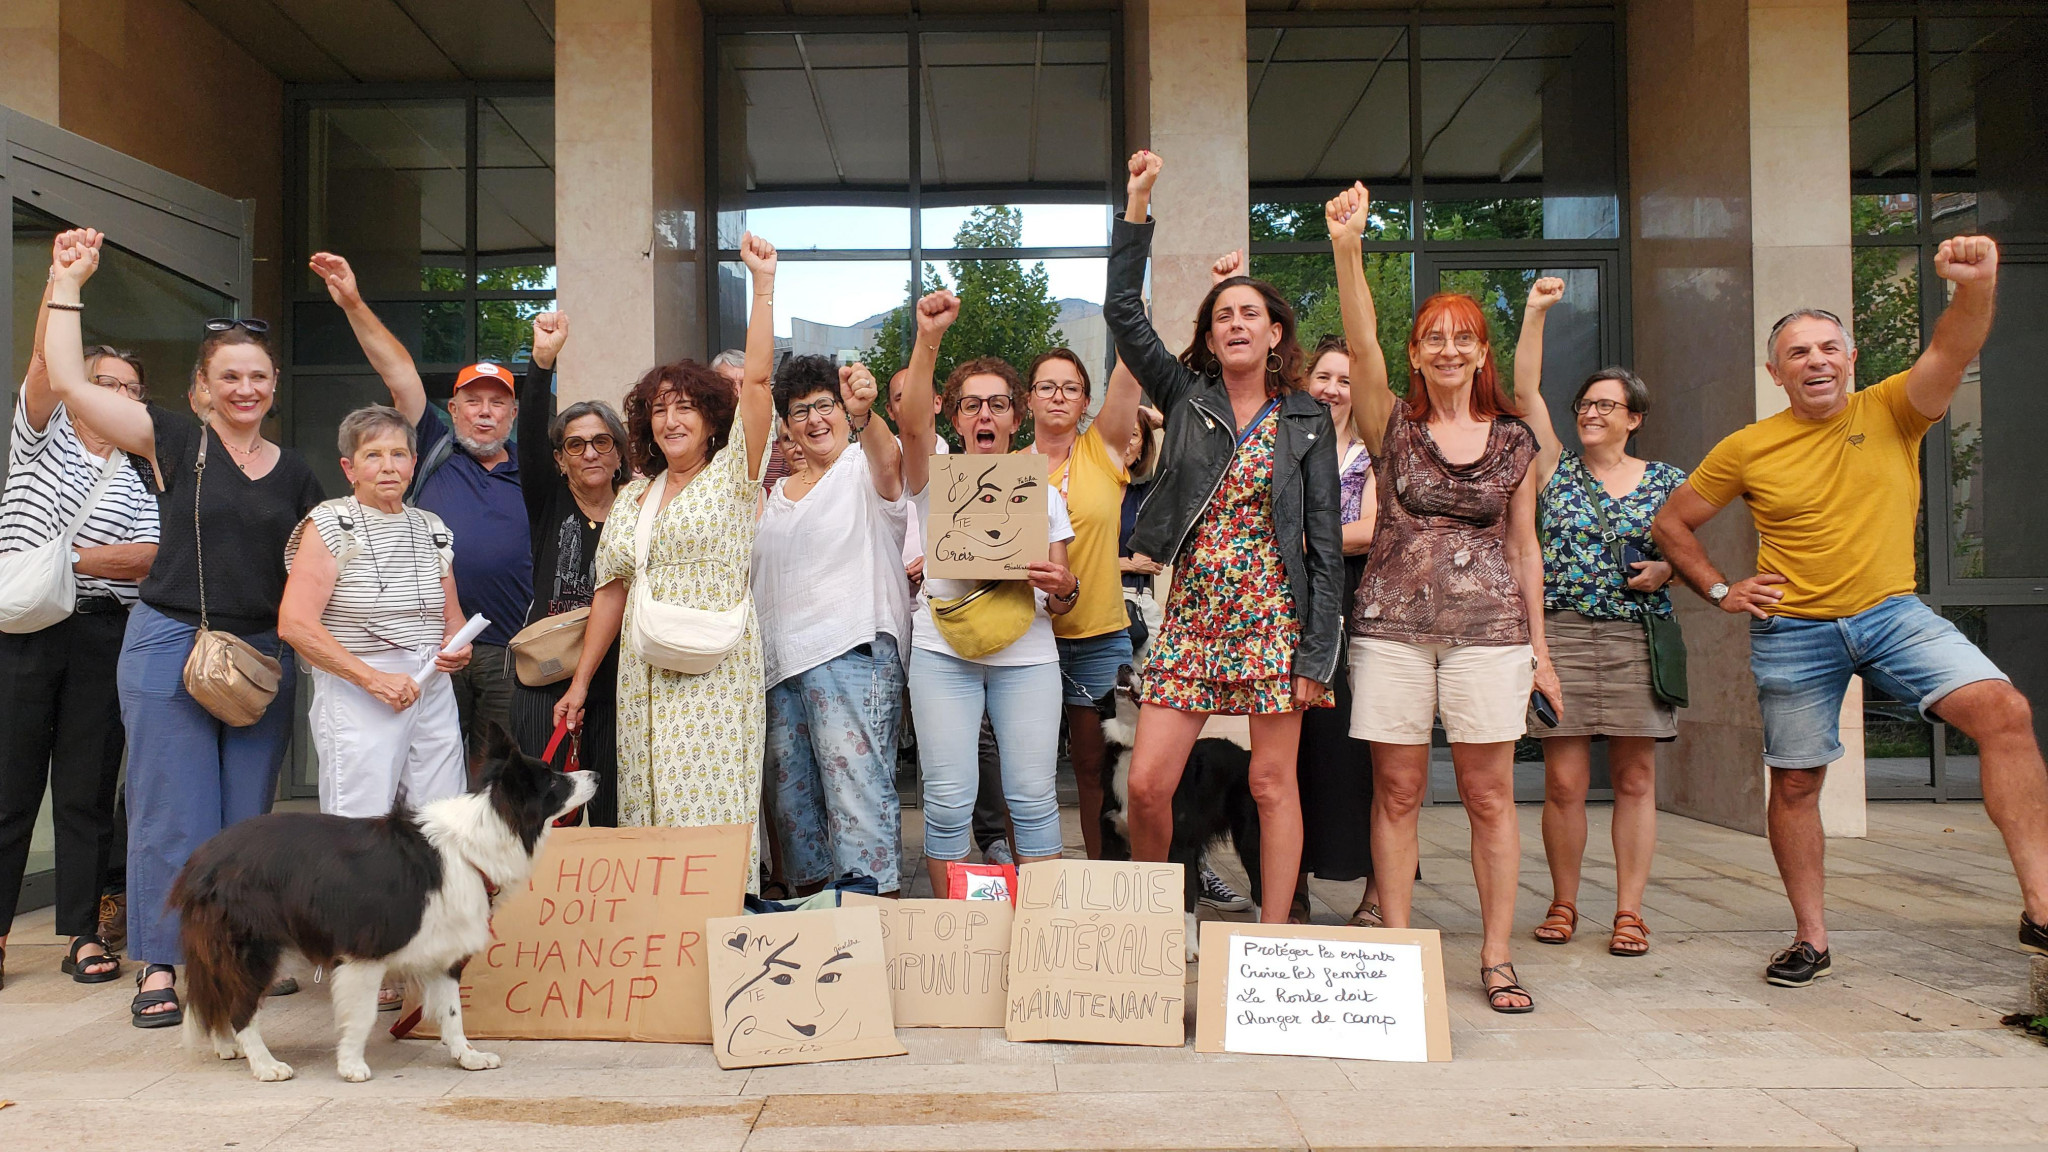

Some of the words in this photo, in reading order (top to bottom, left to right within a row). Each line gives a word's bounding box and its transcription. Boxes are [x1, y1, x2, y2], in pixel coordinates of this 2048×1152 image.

[956, 517, 971, 528] TE
[936, 531, 975, 561] Crois
[557, 855, 717, 896] HONTE
[1021, 869, 1069, 909] LA
[539, 895, 626, 926] DOIT
[879, 908, 988, 941] STOP
[487, 931, 700, 973] CHANGER
[1244, 942, 1314, 962] Protéger
[1318, 944, 1335, 959] les
[1341, 949, 1395, 971] enfants
[1240, 963, 1291, 980] Croire
[1292, 965, 1315, 980] les
[1323, 967, 1387, 988] femmes
[505, 976, 658, 1021] CAMP
[744, 987, 766, 1003] TE
[1009, 984, 1181, 1024] MAINTENANT
[1236, 987, 1266, 1003] La
[1335, 988, 1378, 1003] doit
[1311, 1010, 1336, 1024] de
